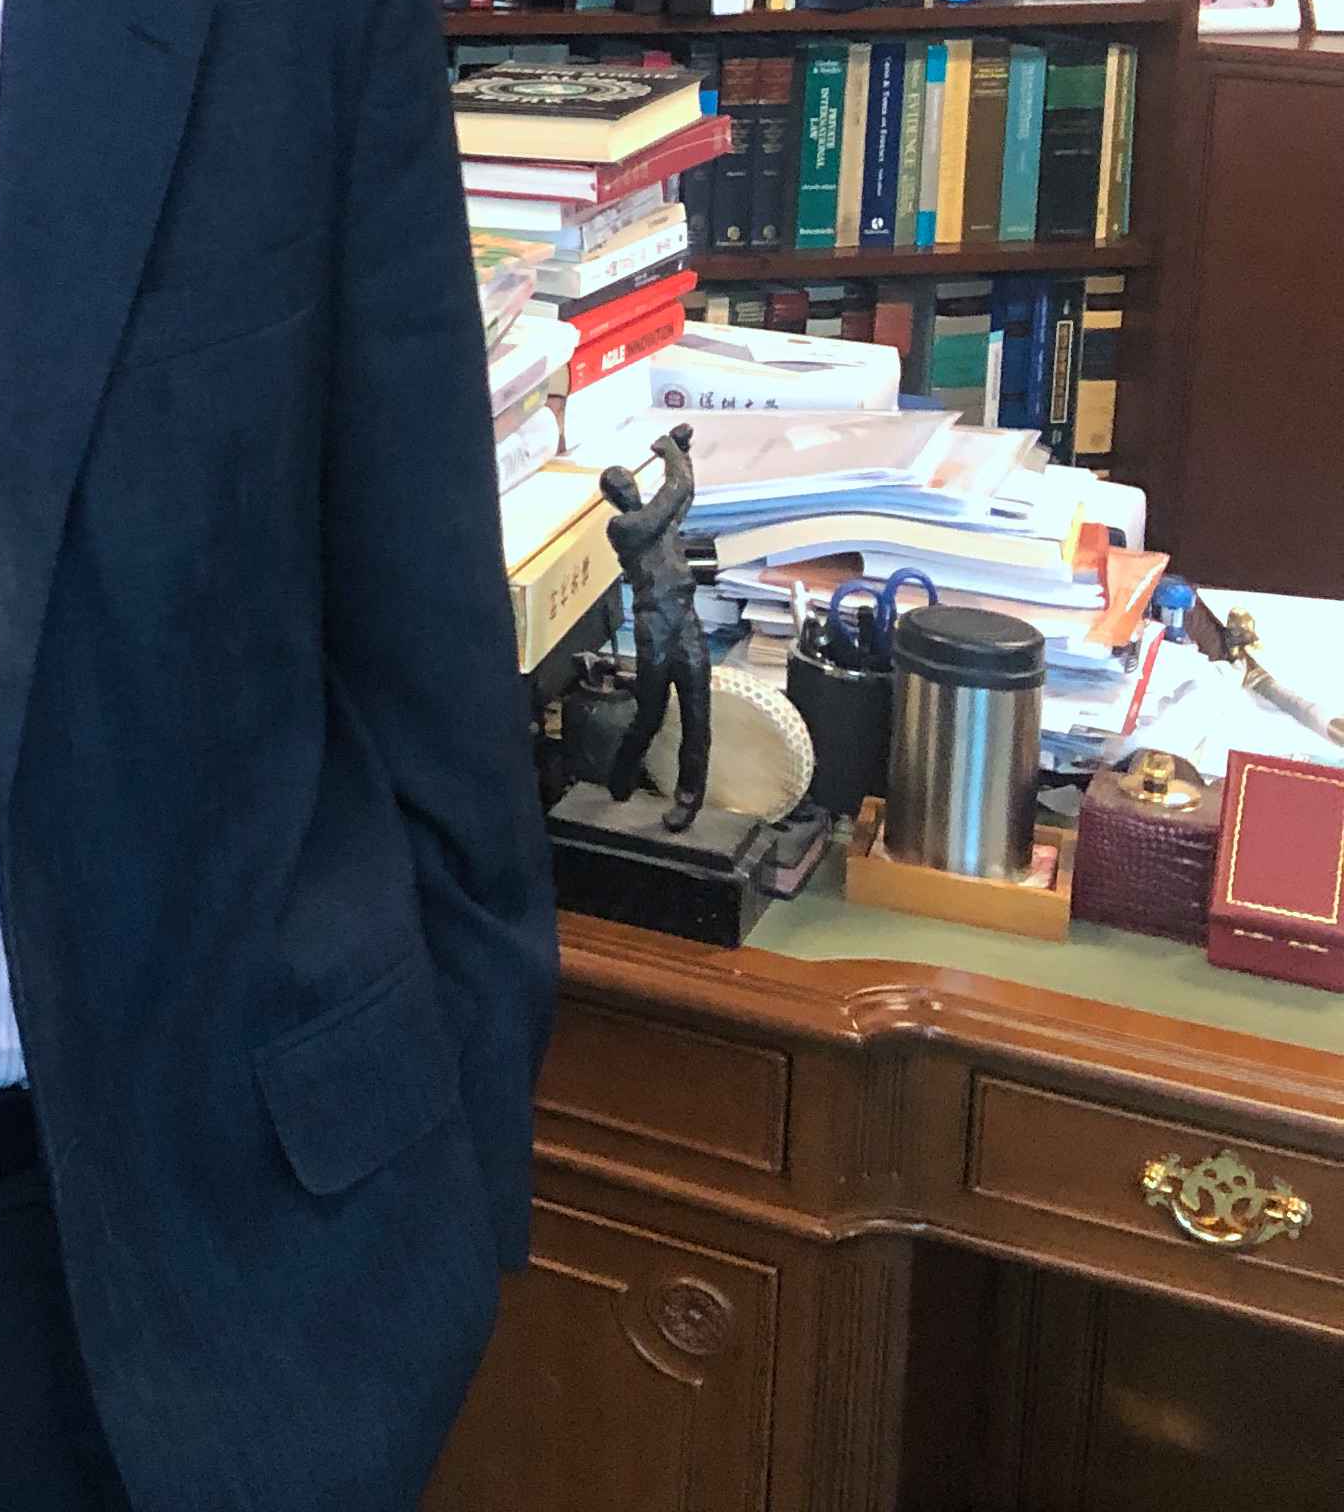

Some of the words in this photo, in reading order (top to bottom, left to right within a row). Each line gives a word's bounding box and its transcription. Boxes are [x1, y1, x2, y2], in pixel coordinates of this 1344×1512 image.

[810, 117, 818, 139] LAW
[816, 87, 829, 168] INTERNATIONAL
[904, 92, 920, 167] EVIDENCE
[601, 344, 626, 371] AGILE
